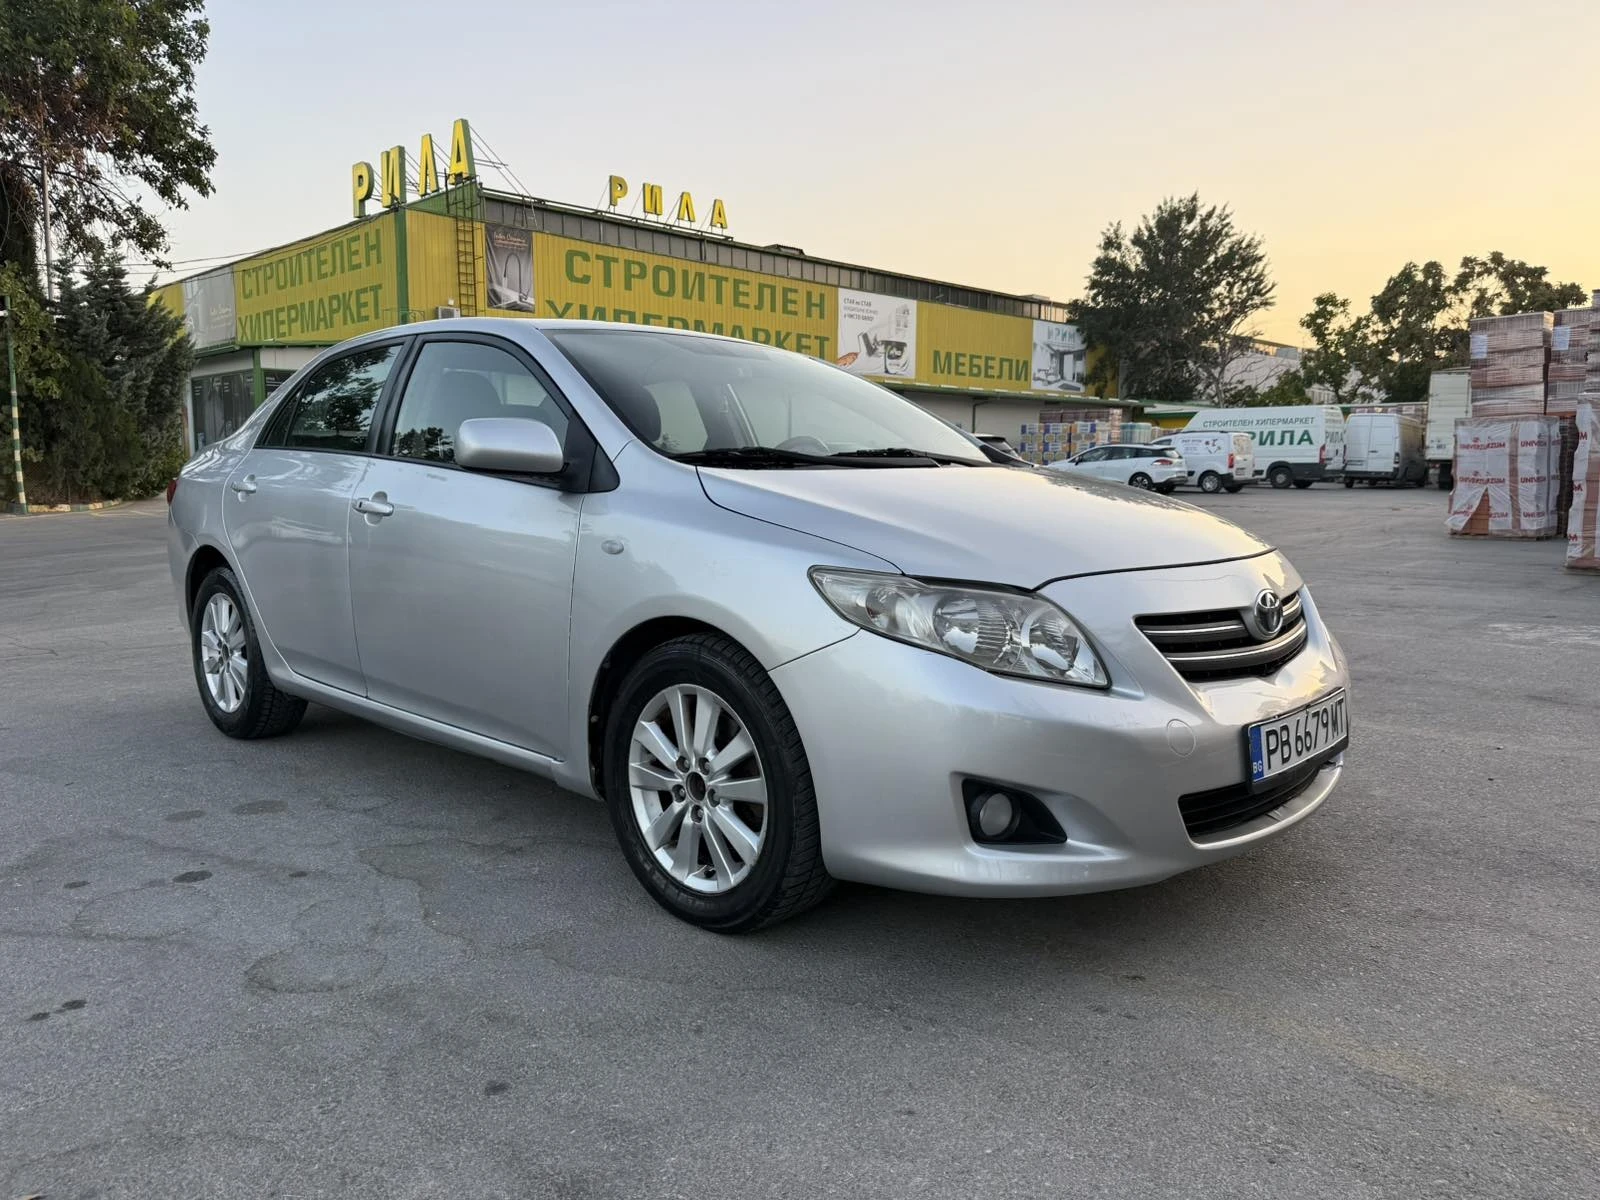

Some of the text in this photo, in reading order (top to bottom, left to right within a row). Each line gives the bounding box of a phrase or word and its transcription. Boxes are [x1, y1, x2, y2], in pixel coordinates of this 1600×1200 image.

[352, 118, 477, 218] РИЛА
[609, 175, 728, 229] РИЛА
[240, 228, 383, 299] СТРОИТЕЛЕН
[565, 249, 826, 320] СТРОИТЕЛЕН
[238, 283, 383, 342] ХИПЕРМАРКЕТ
[933, 350, 1029, 382] МЕБЕЛИ
[1203, 419, 1254, 428] СТРОИТЕЛЕН
[1255, 416, 1316, 426] ХИПЕРМАРКЕТ
[1252, 761, 1263, 774] BG
[1265, 724, 1292, 770] PB
[1295, 707, 1329, 757] 6679
